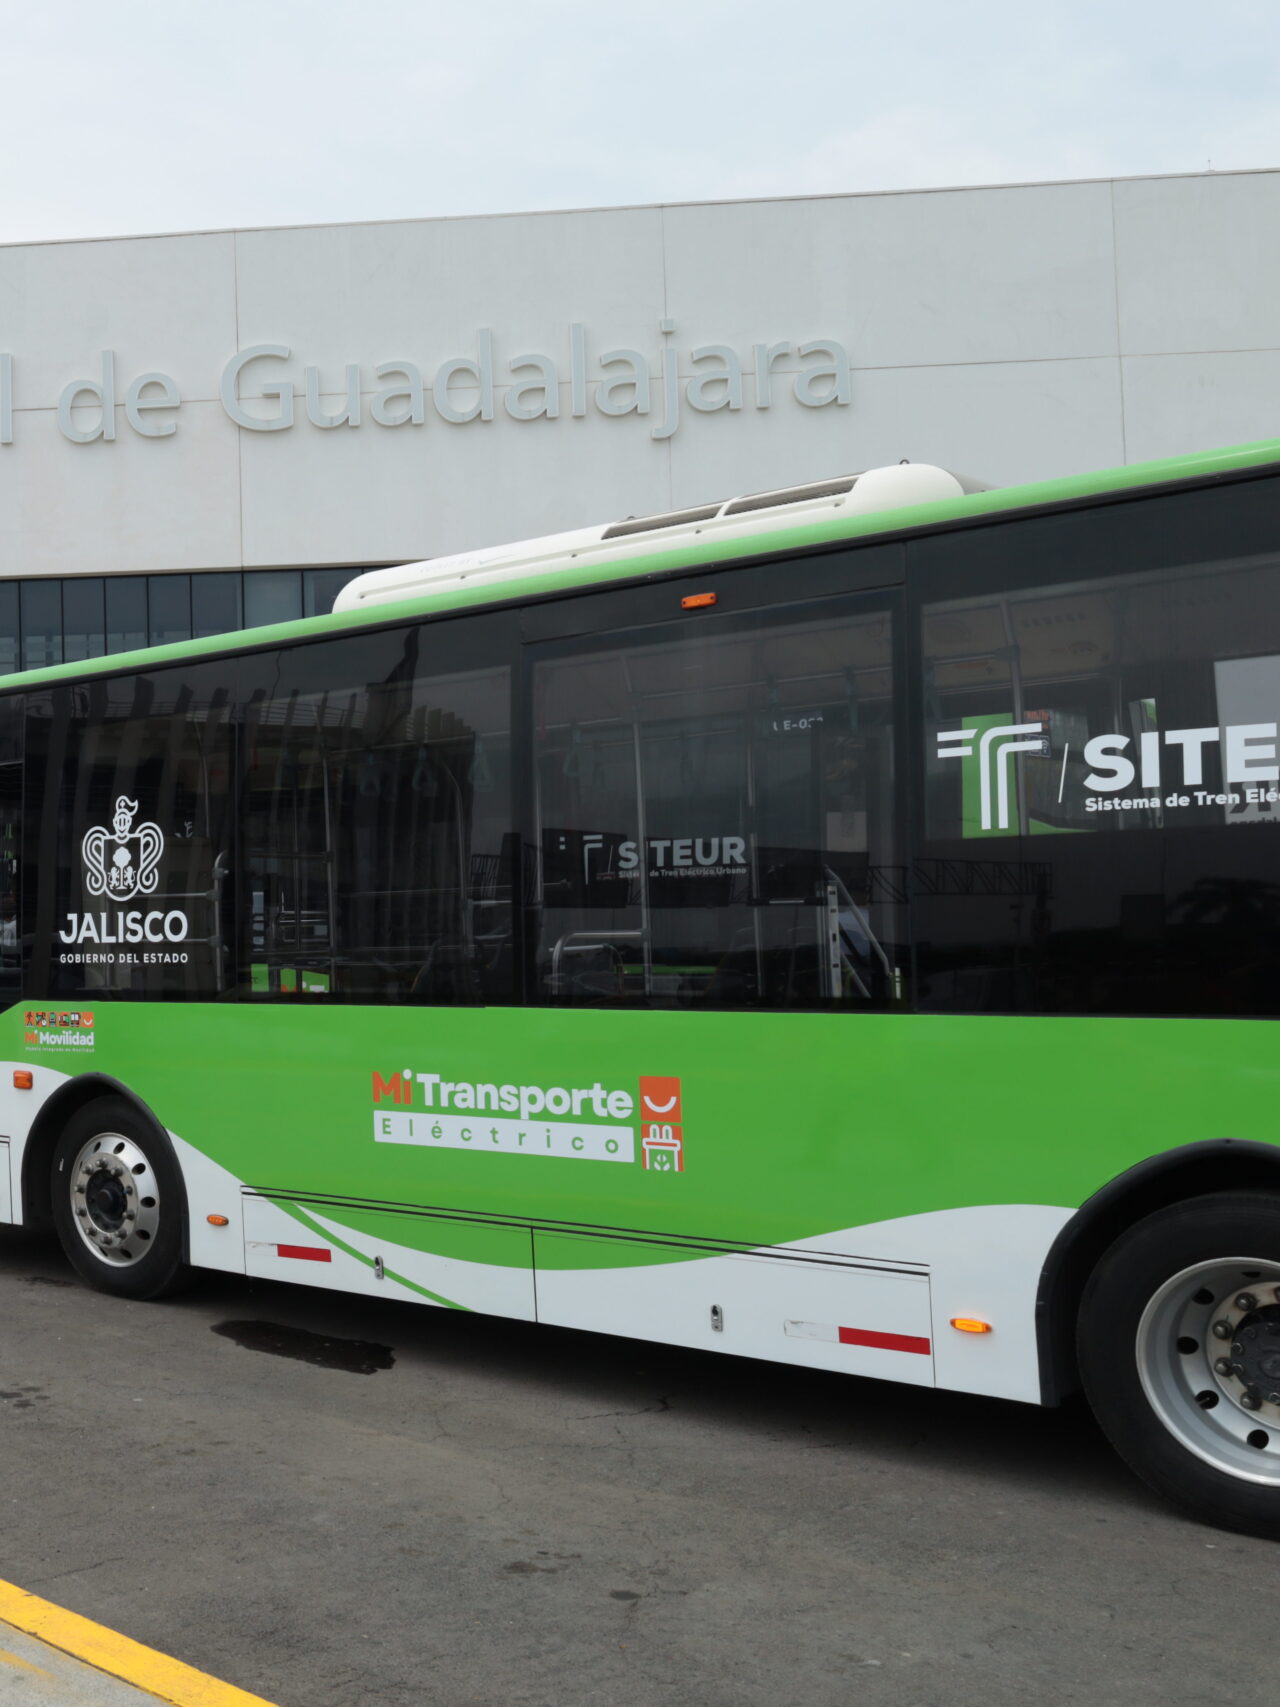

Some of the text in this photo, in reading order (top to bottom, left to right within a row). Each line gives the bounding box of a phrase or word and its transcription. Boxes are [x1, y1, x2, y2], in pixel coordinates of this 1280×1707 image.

[57, 349, 182, 444] de
[220, 318, 852, 441] Guadalajara
[1083, 722, 1280, 792] SITE
[1085, 797, 1161, 812] Sistema
[1165, 793, 1190, 807] de
[1193, 791, 1240, 806] Tren
[1245, 787, 1280, 803] Elé
[618, 836, 746, 869] STEUR
[59, 910, 188, 943] JALISCO
[60, 953, 188, 963] GOBIERNO DEL ESTADO
[24, 1029, 95, 1046] Mi Movilidad
[372, 1068, 634, 1120] Mi Transporte
[382, 1117, 619, 1154] Eléctrico
